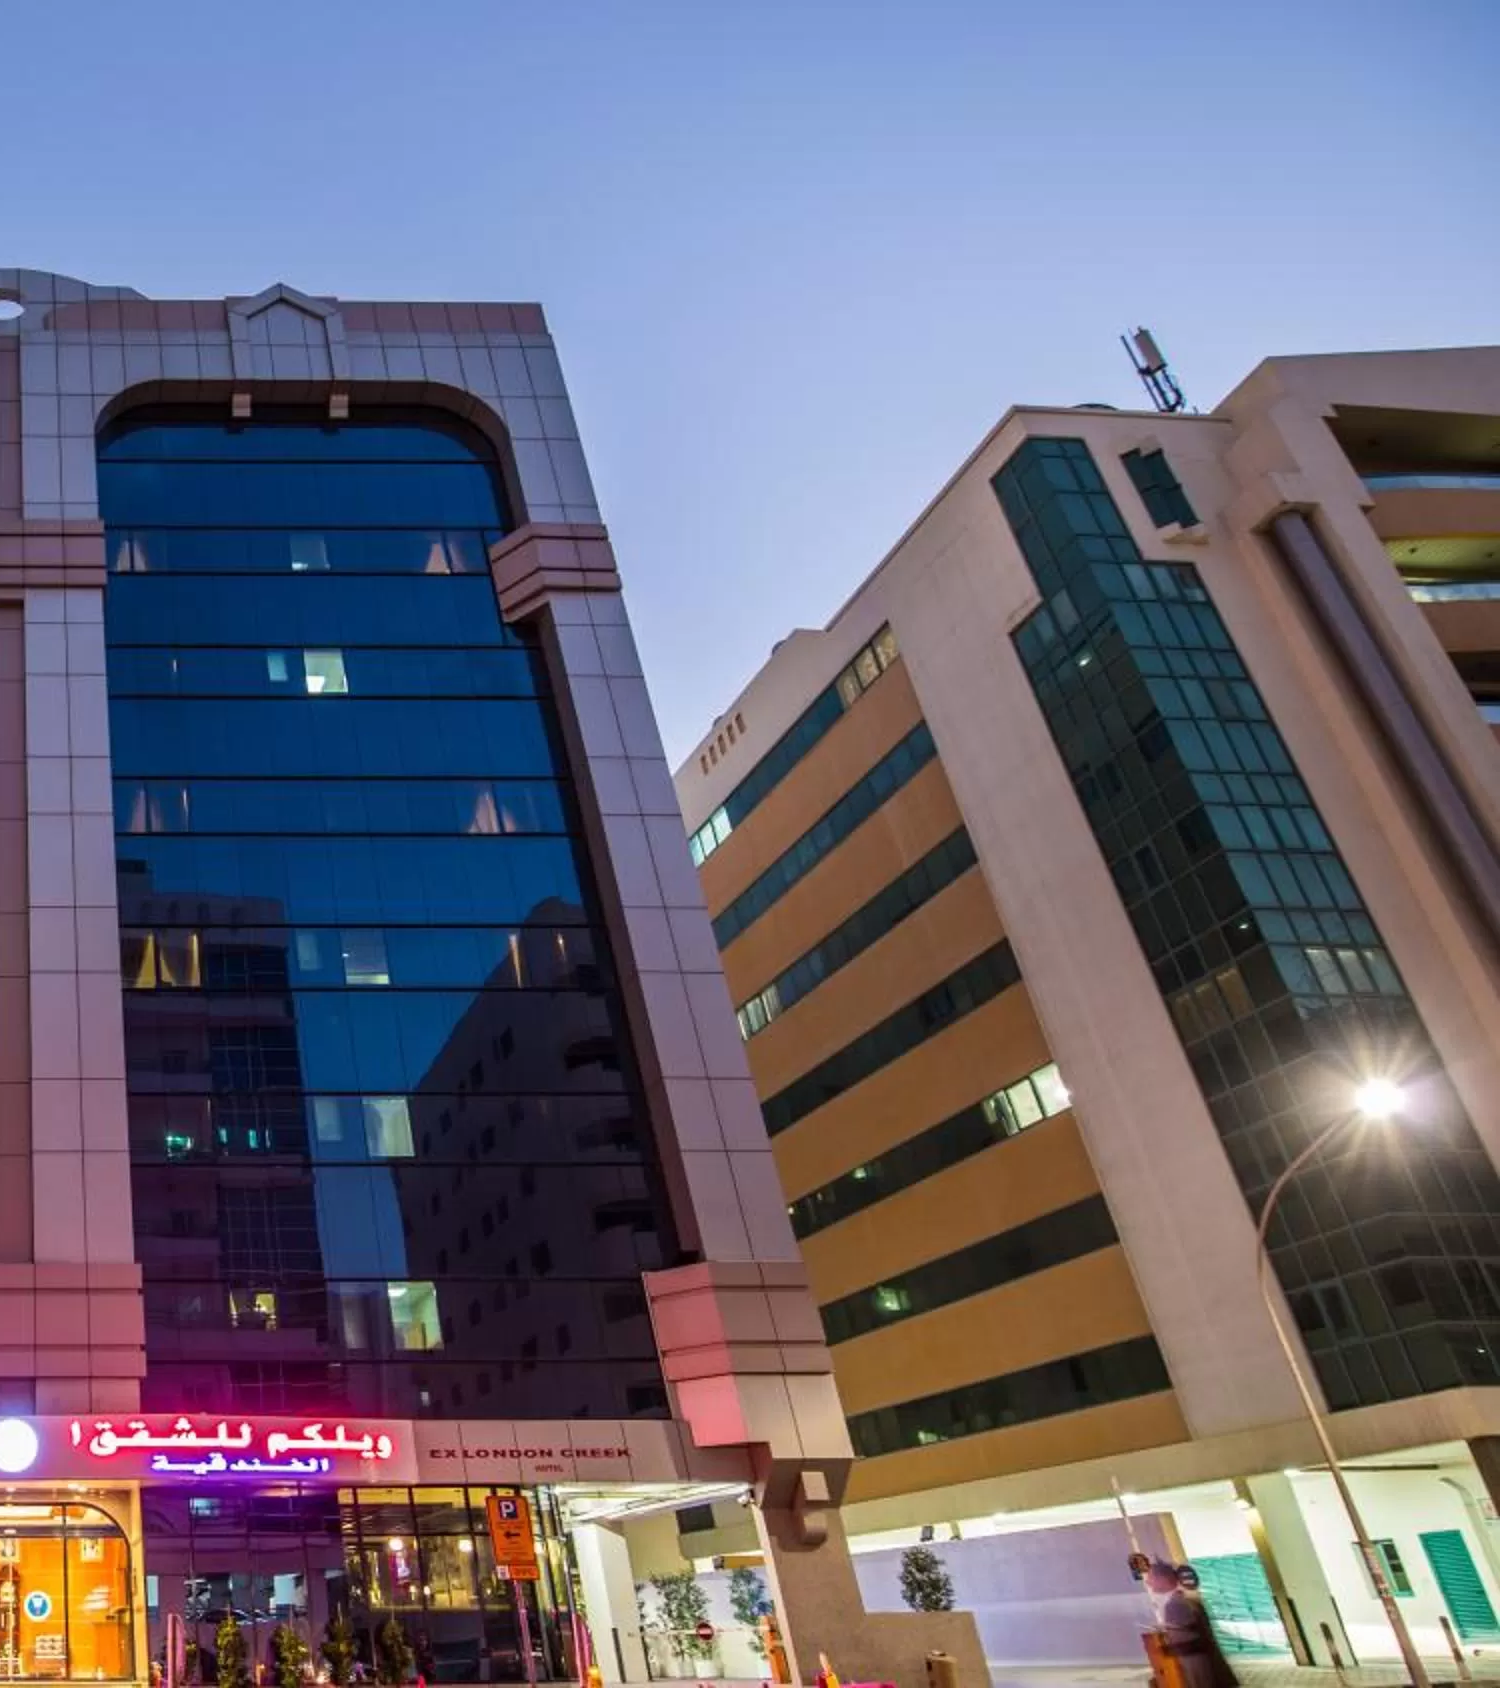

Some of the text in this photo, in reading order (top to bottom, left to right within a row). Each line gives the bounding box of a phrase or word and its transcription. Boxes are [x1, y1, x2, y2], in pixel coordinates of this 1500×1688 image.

[89, 1417, 252, 1456] للشقق
[267, 1424, 393, 1459] ويلكم
[151, 1451, 329, 1475] الفندقية
[429, 1448, 632, 1460] EX LONDON CREEK
[500, 1501, 515, 1518] P
